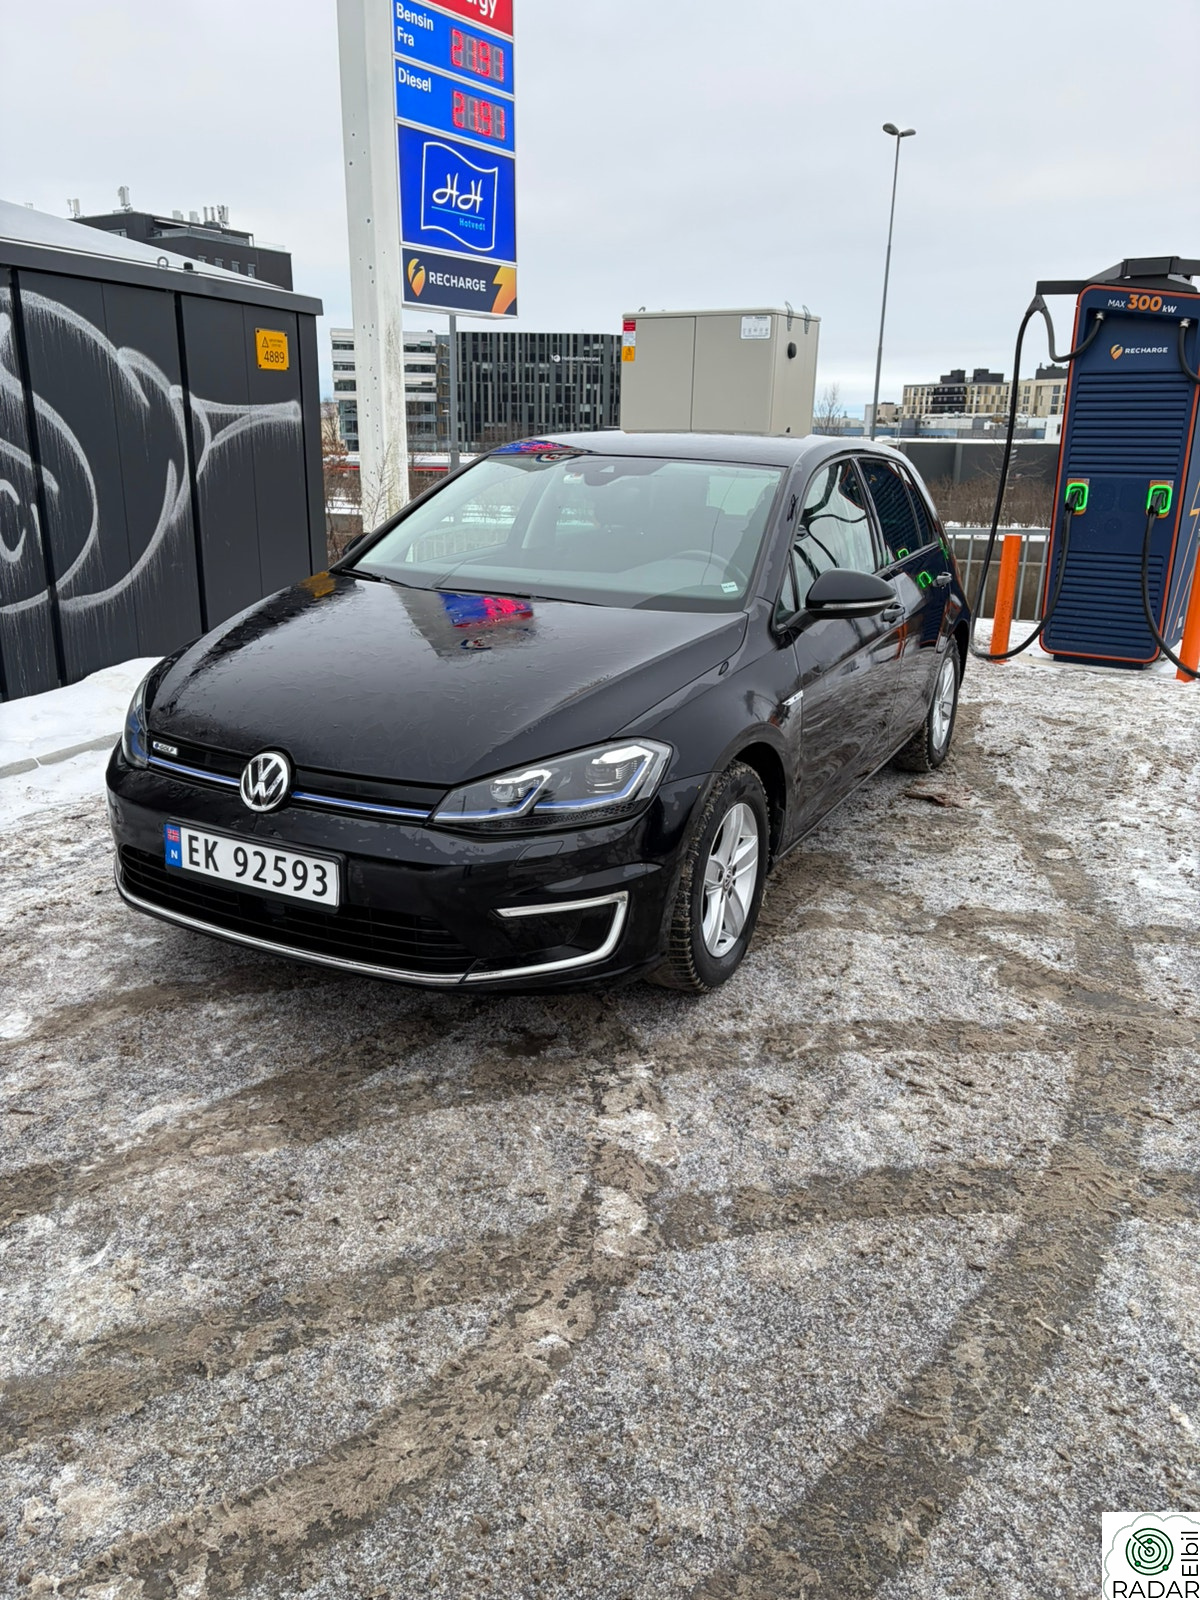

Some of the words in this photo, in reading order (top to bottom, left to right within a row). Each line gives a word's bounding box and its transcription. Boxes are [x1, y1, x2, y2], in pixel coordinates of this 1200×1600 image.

[396, 3, 434, 31] Bensin
[397, 26, 415, 47] Fra
[398, 67, 431, 92] Diesel
[459, 218, 485, 231] Hotvedt
[429, 271, 487, 292] RECHARGE
[1108, 299, 1126, 308] MAX
[1127, 294, 1163, 312] 300
[1162, 305, 1177, 313] kW
[264, 350, 285, 364] 4889
[171, 849, 178, 860] N
[187, 834, 220, 873] EK
[233, 846, 328, 897] 92593
